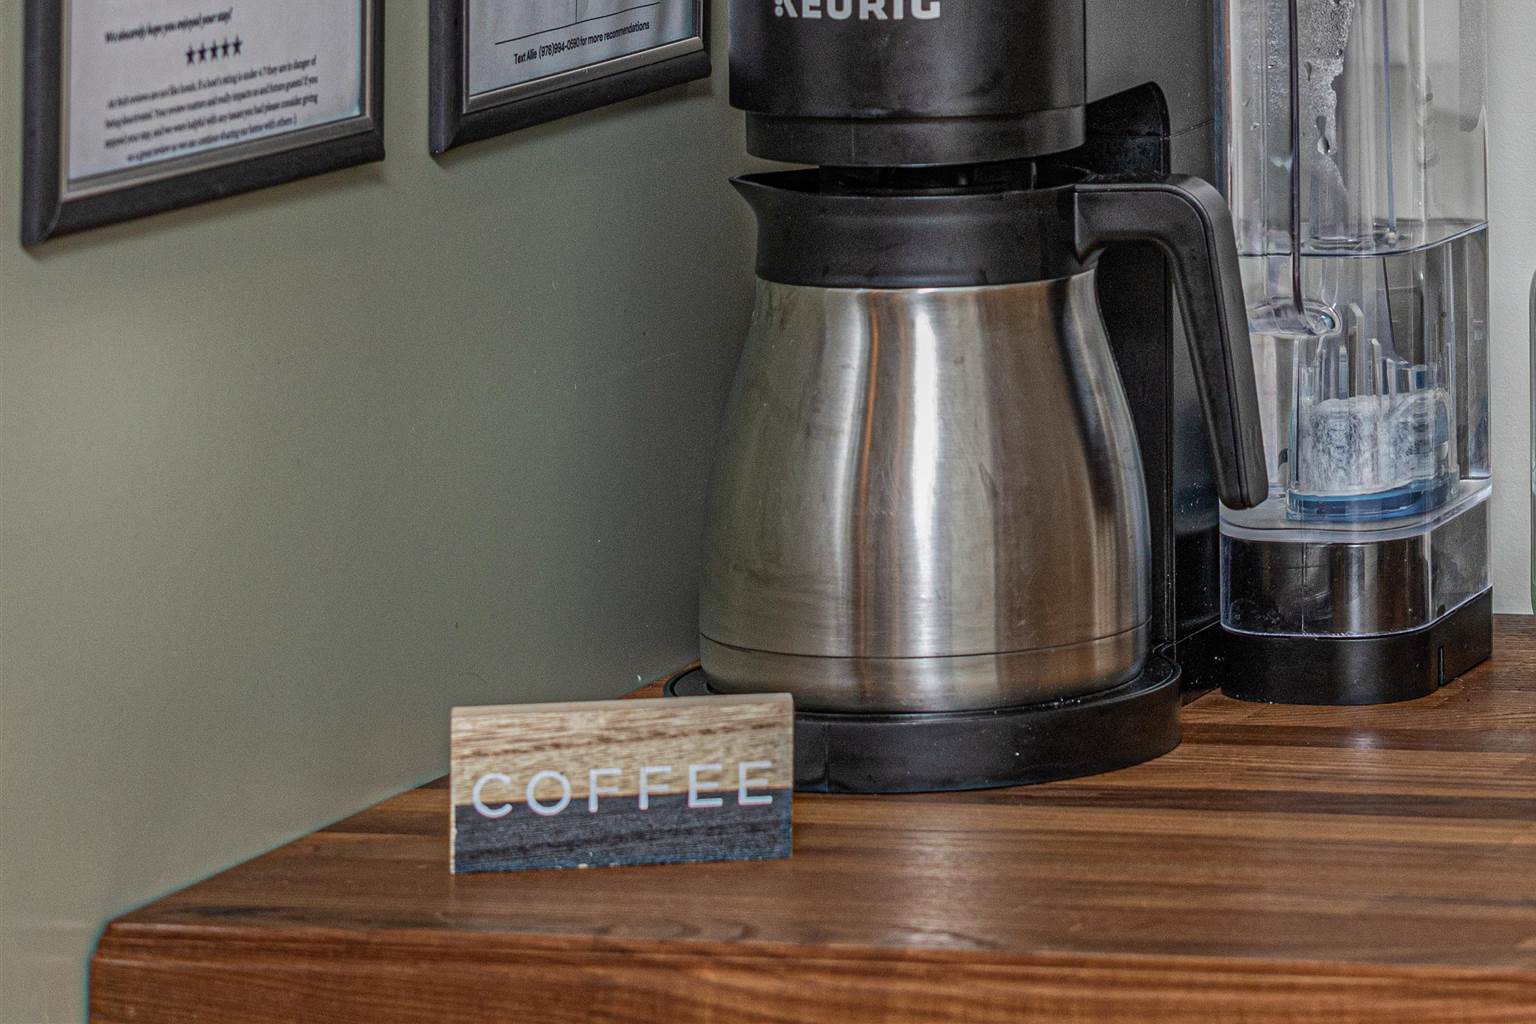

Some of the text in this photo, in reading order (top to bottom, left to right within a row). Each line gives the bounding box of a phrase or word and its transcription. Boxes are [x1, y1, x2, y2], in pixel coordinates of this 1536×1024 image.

[513, 50, 527, 65] Text
[526, 47, 538, 62] Allie
[588, 32, 604, 46] more
[603, 21, 651, 42] recommendations
[472, 759, 774, 819] COFFEE
